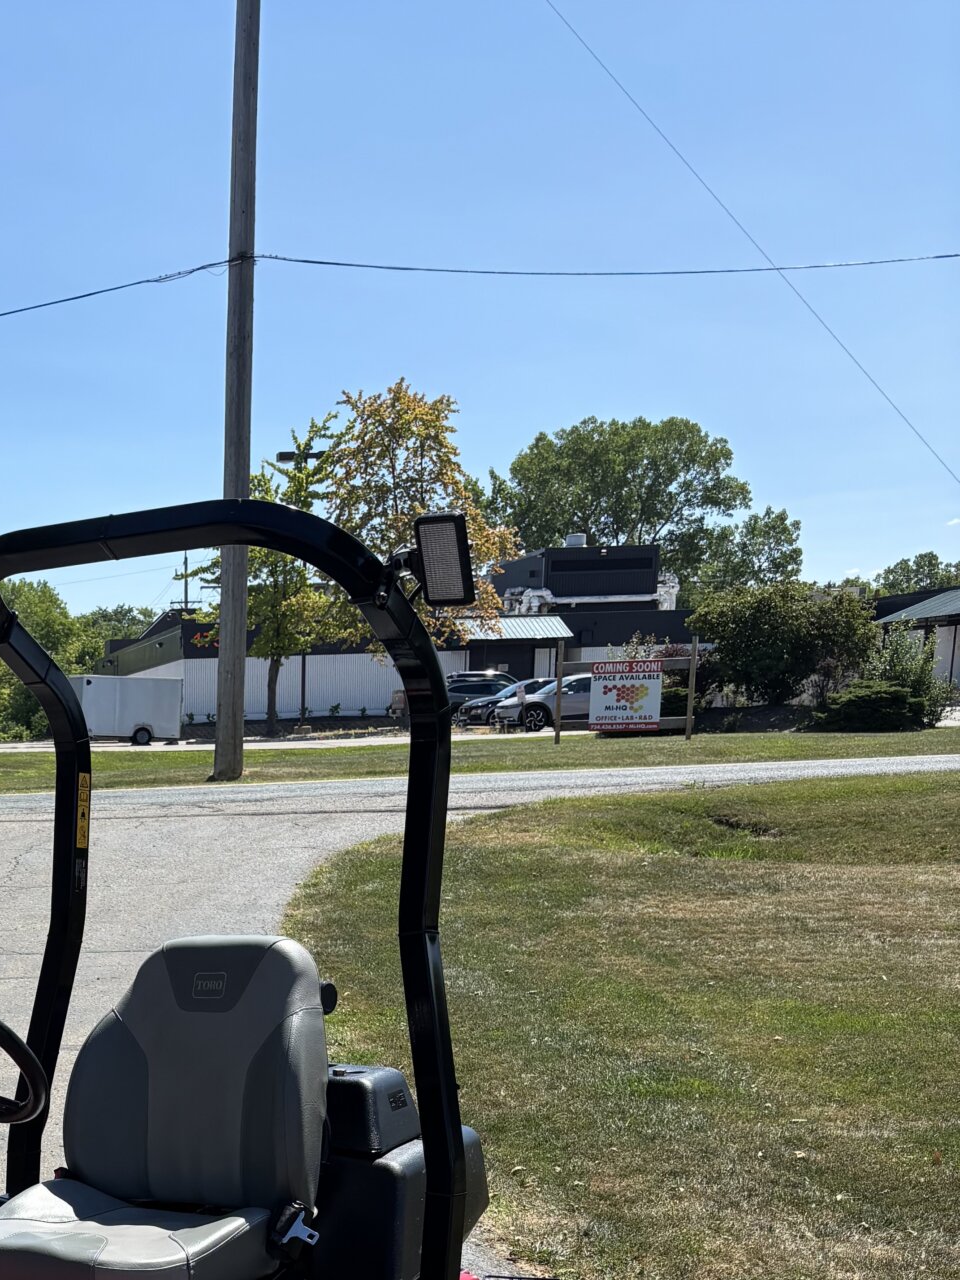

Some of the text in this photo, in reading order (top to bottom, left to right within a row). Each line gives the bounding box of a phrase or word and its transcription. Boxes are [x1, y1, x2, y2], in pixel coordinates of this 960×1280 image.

[593, 662, 661, 673] COMING SOON!
[619, 673, 660, 681] AVAILABLE
